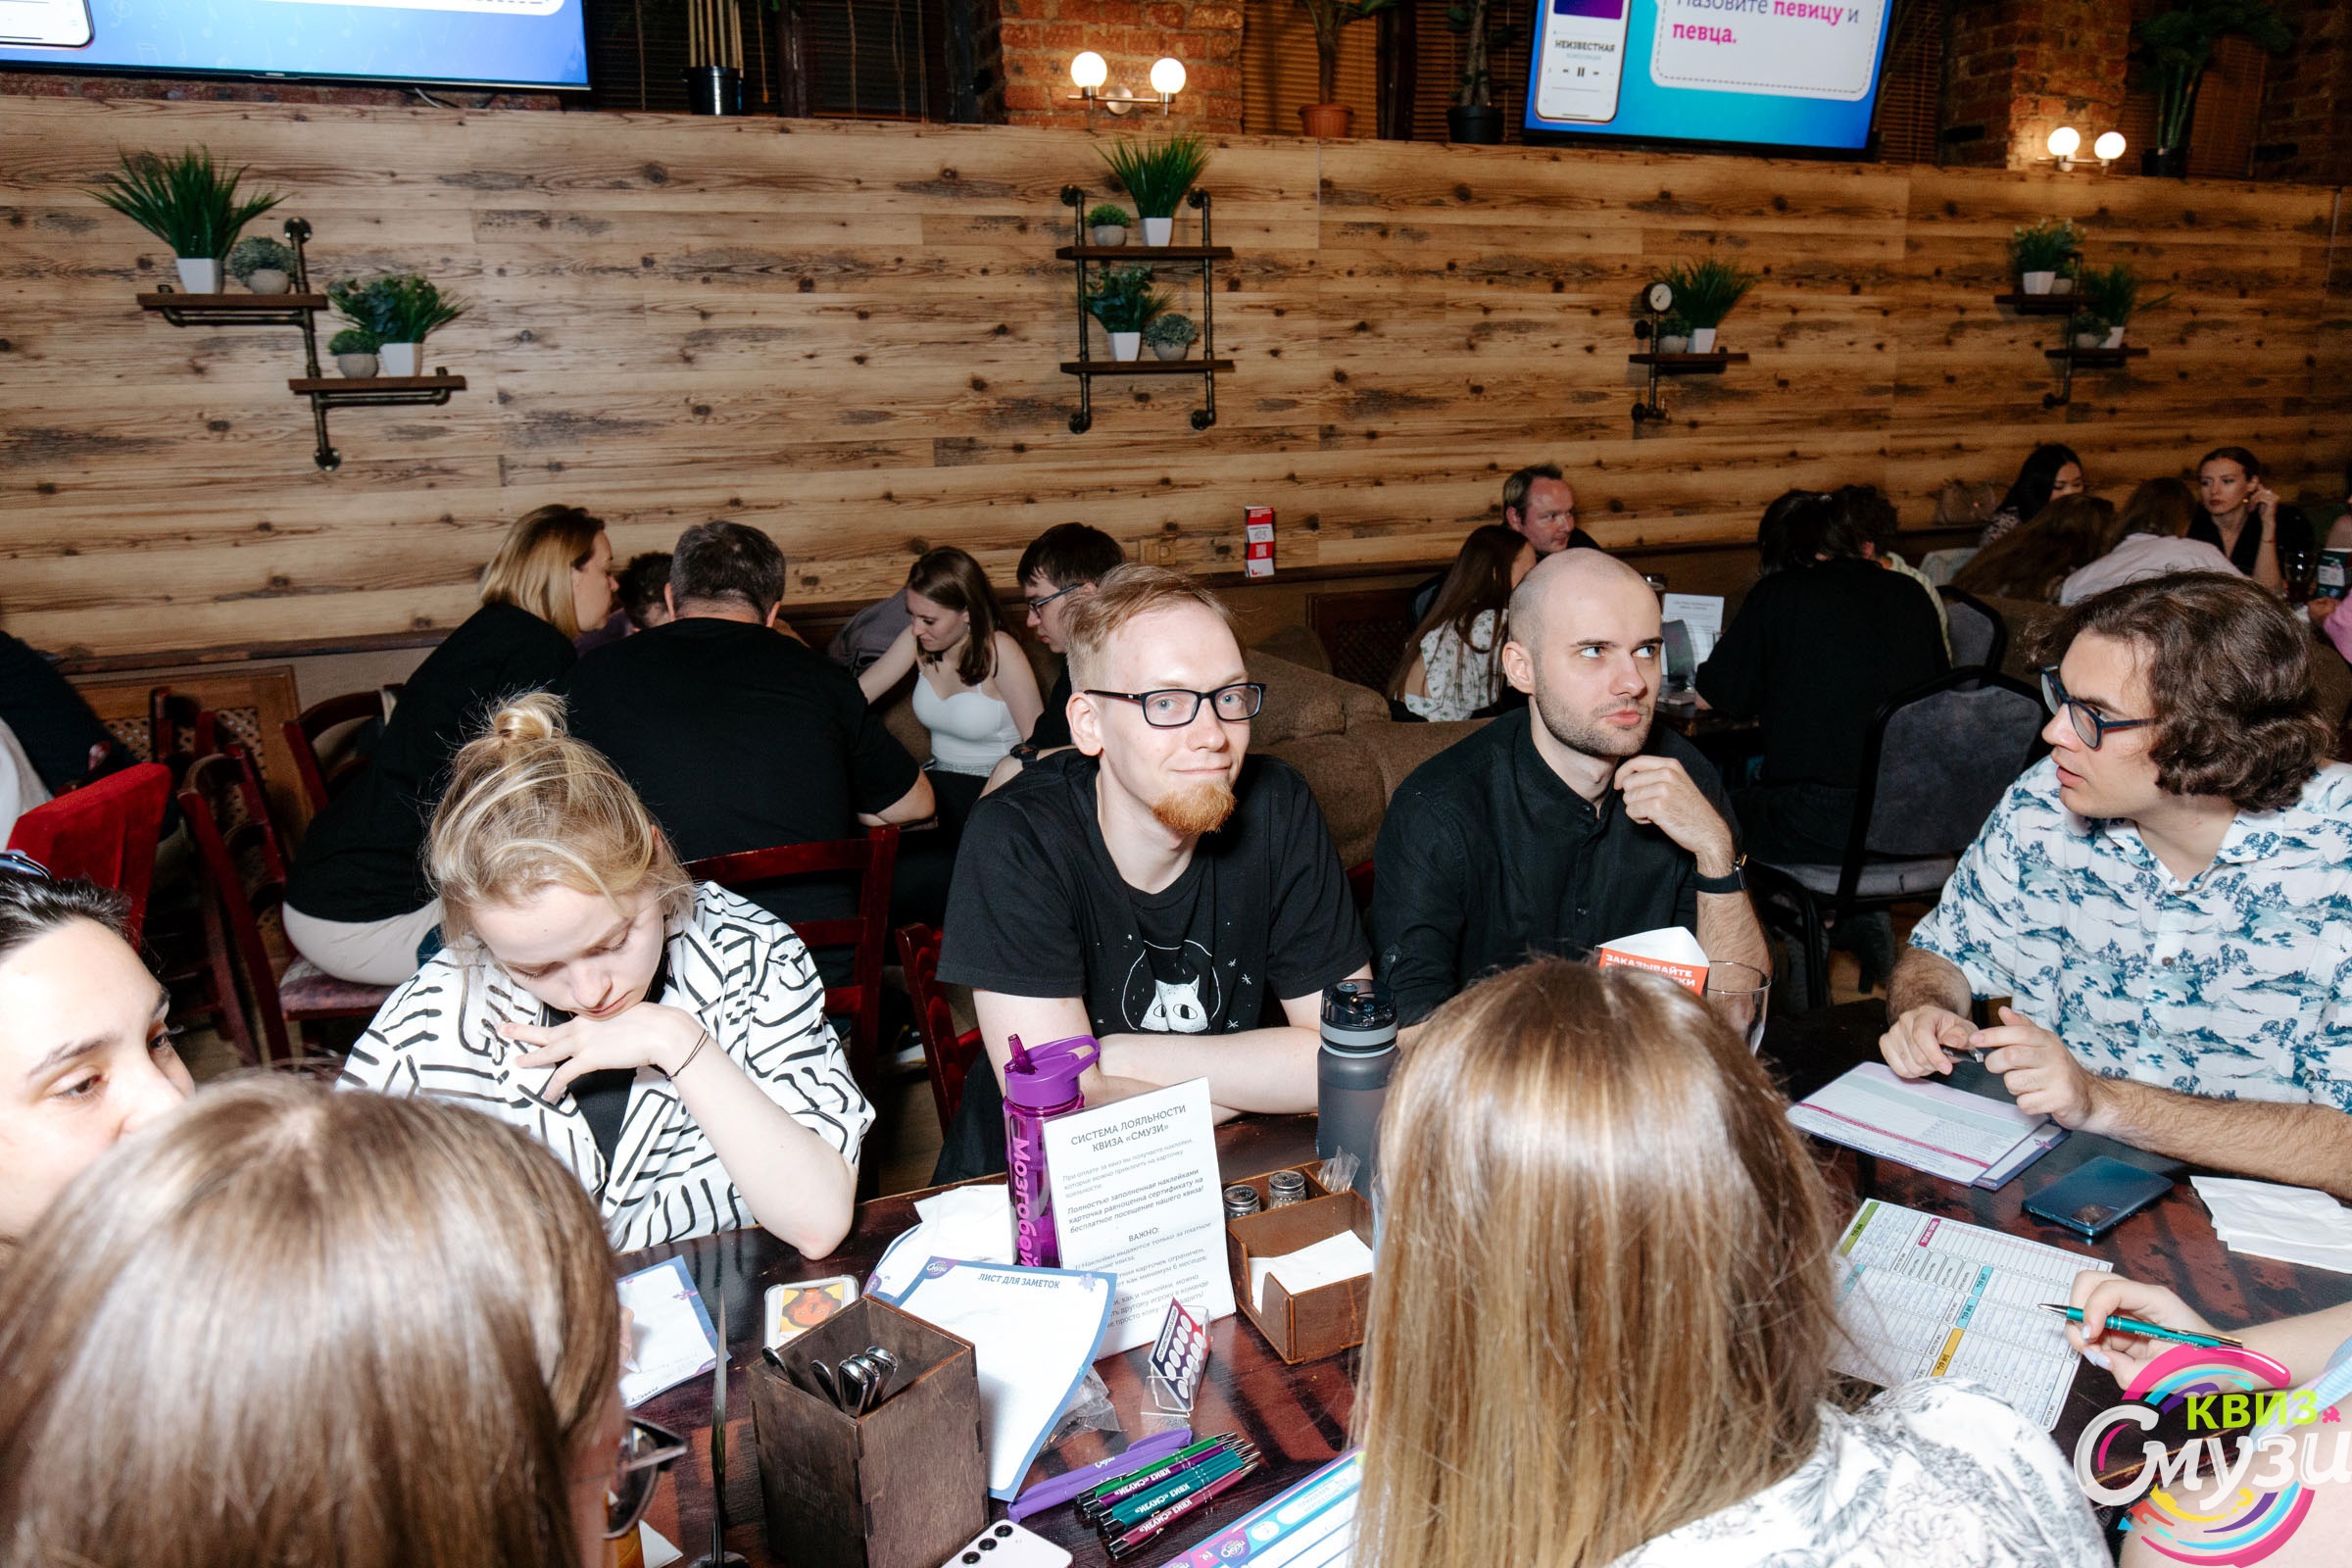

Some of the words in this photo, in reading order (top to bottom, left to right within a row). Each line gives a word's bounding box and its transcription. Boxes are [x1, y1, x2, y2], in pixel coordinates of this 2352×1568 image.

[1773, 0, 1843, 26] певицу
[1847, 8, 1859, 24] и
[1555, 39, 1616, 53] НЕИЗВЕСТНАЯ
[1673, 24, 1738, 46] певца.
[1605, 954, 1693, 978] ЗАКАЗЫВАЙТЕ
[1070, 1124, 1119, 1146] СИСТЕМА
[1120, 1104, 1187, 1131] ЛОЯЛЬНОСТИ
[1092, 1136, 1124, 1152] КВИЗА
[1125, 1124, 1169, 1142] «СМУЗИ»
[1012, 1137, 1039, 1267] Мозгобой
[1068, 1198, 1108, 1214] Полностью
[1110, 1183, 1156, 1200] заполненная
[1157, 1169, 1199, 1186] наклейками
[1069, 1209, 1102, 1224] карточка
[1104, 1196, 1147, 1213] равноценна
[1149, 1180, 1193, 1200] сертификату
[1070, 1215, 1112, 1233] бесплатное
[1114, 1202, 1153, 1218] посещение
[1155, 1194, 1181, 1205] нашего
[1183, 1186, 1203, 1197] квиза!
[978, 1273, 1003, 1283] ЛИСТ
[1002, 1276, 1021, 1285] ДЛЯ
[1021, 1278, 1060, 1289] ЗАМЕТОК
[1150, 1467, 1171, 1481] КВИЗ
[1114, 1477, 1150, 1495] «СМУЗИ»
[1169, 1483, 1191, 1497] КВИЗ
[1135, 1494, 1168, 1513] «СМУЗИ»
[1172, 1498, 1193, 1514] КВИЗ
[1139, 1510, 1172, 1533] «СМУЗИ»
